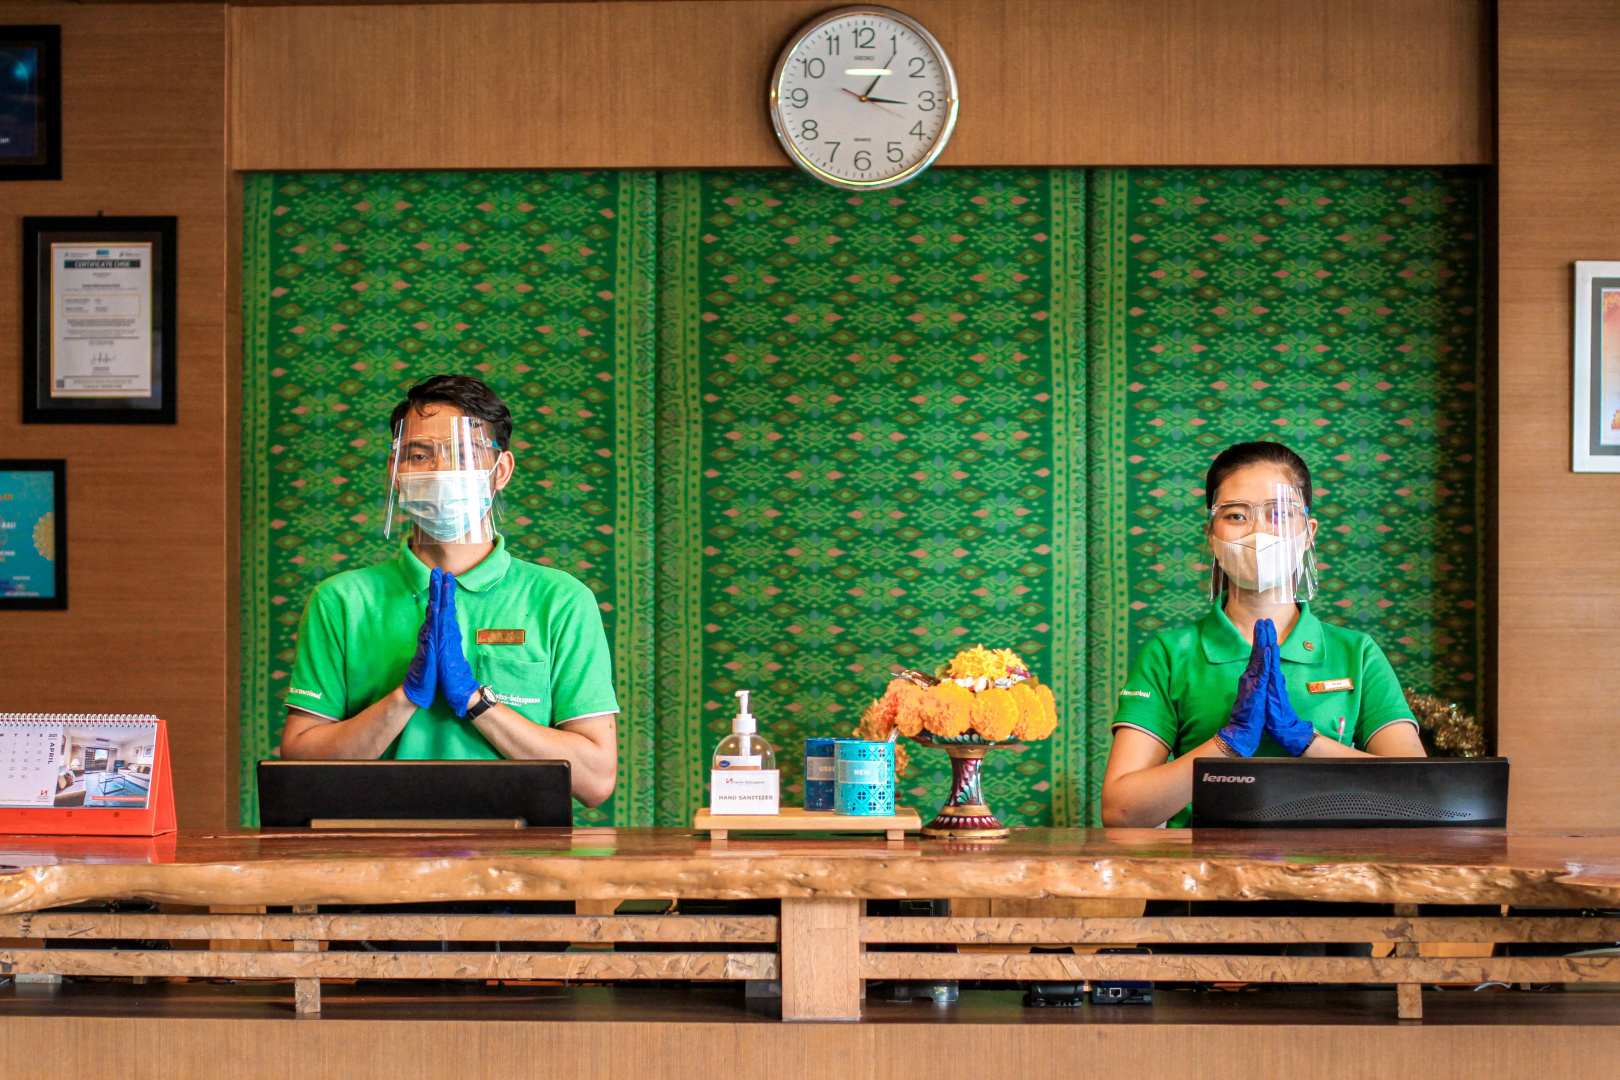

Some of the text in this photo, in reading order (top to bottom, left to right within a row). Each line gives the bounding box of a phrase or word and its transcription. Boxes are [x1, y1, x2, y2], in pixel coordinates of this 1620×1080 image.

[826, 35, 840, 55] 11
[852, 27, 875, 49] 12
[890, 34, 897, 55] 1
[801, 57, 825, 79] 10
[908, 57, 925, 78] 2
[791, 88, 808, 109] 9
[917, 90, 936, 111] 3
[801, 119, 819, 141] 8
[909, 120, 926, 141] 4
[824, 141, 841, 163] 7
[854, 150, 872, 171] 6
[887, 141, 904, 163] 5
[47, 742, 56, 765] APRIL
[1202, 773, 1256, 784] lenovo
